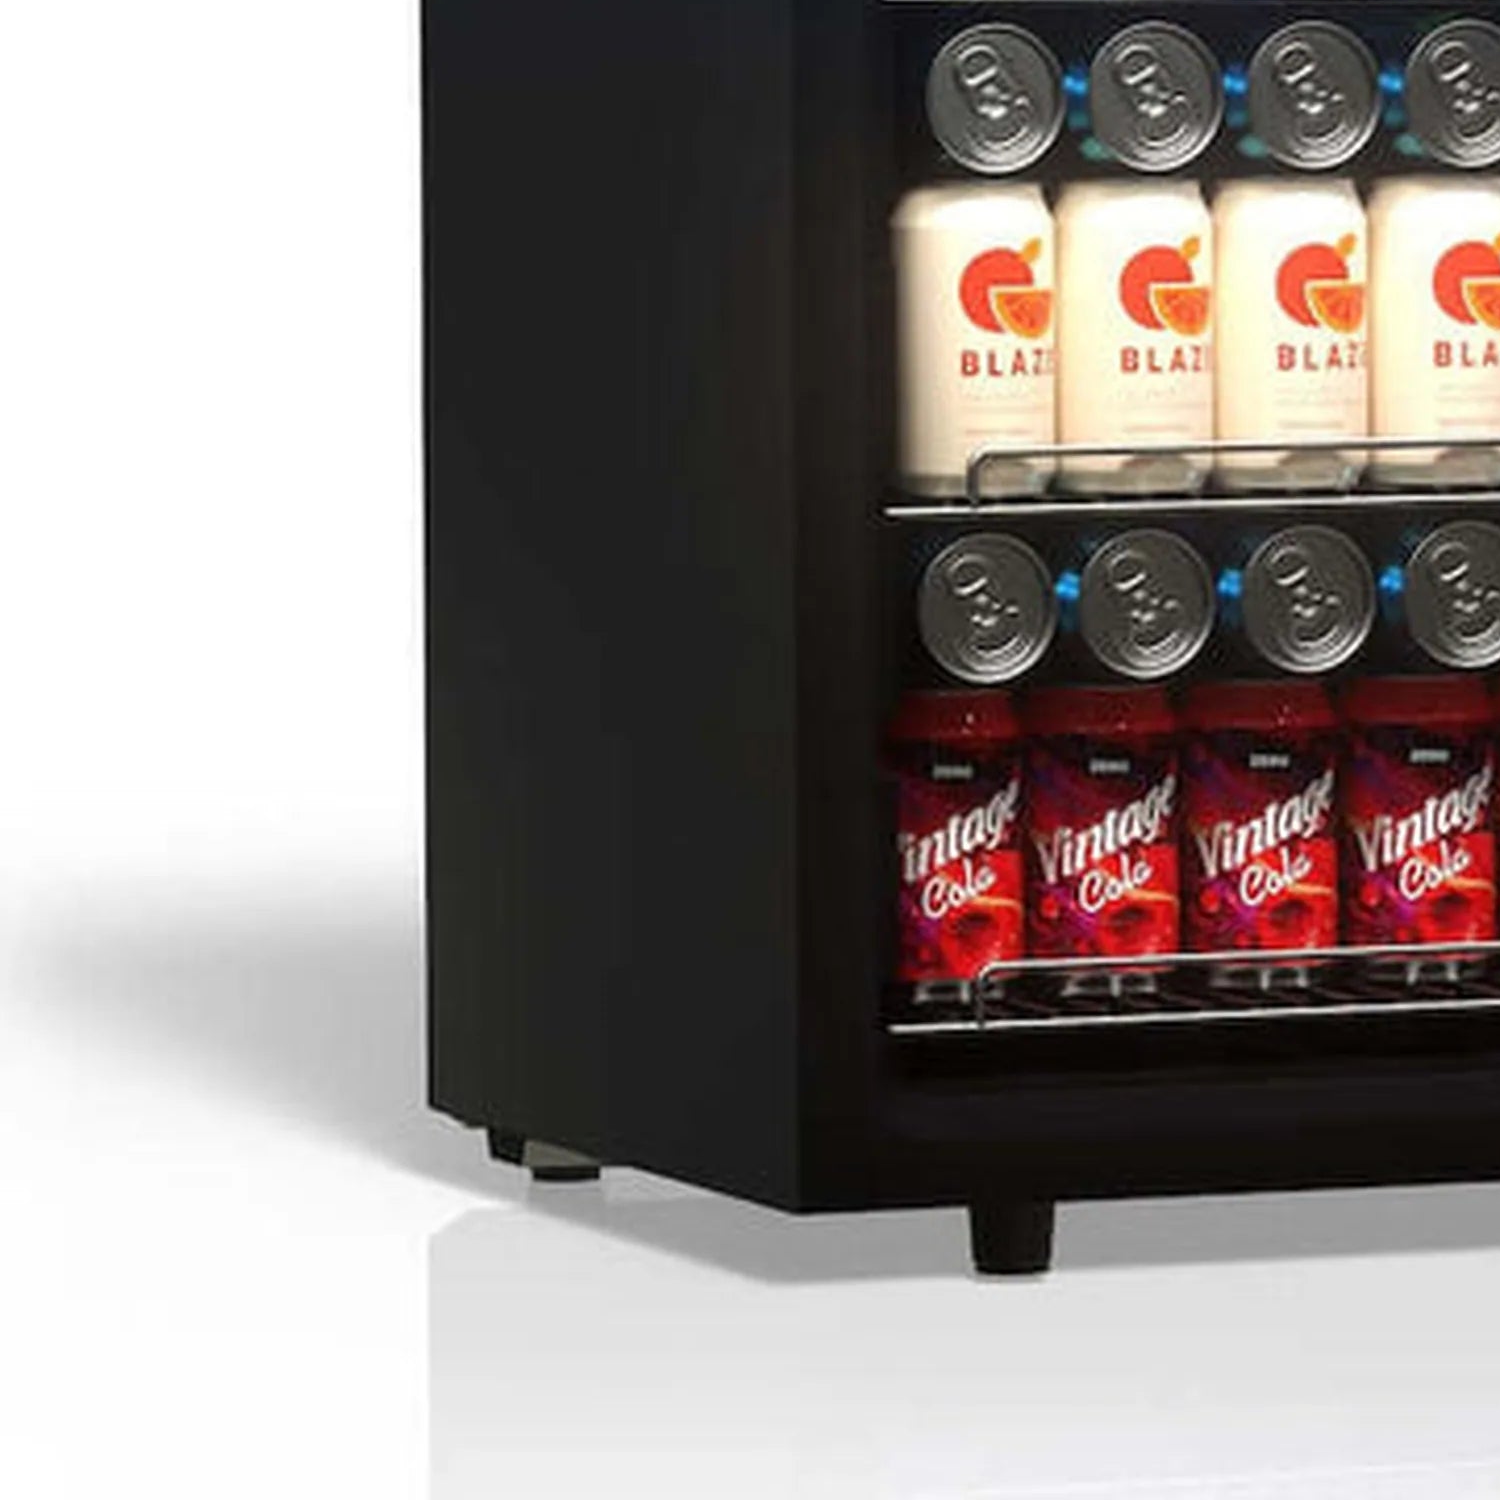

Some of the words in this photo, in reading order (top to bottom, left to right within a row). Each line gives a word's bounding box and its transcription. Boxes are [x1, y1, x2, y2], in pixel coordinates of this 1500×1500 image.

[1120, 347, 1211, 374] BLAZ
[1277, 342, 1366, 371] BLAZ
[901, 780, 1019, 884] intage
[921, 857, 997, 920] Cola
[1078, 852, 1153, 913] Cola
[1239, 846, 1313, 907] Cola
[1399, 839, 1471, 900] Cola
